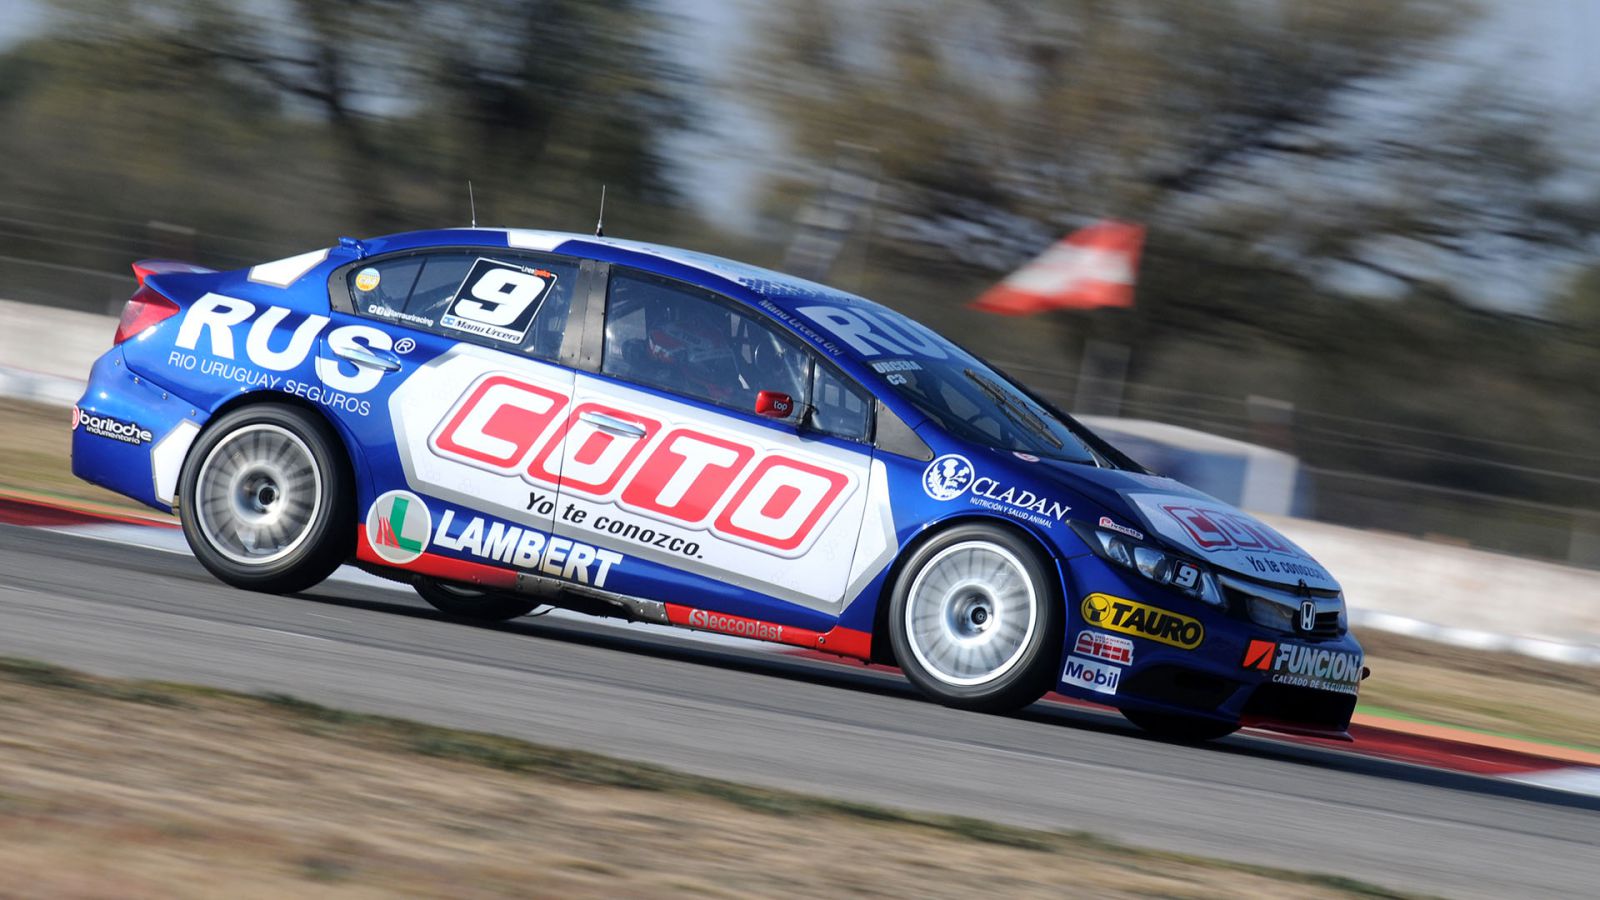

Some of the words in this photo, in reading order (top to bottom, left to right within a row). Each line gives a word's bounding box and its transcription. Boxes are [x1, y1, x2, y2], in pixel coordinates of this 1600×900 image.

[454, 268, 546, 326] 9
[454, 320, 484, 333] Manu
[485, 326, 520, 341] Urcera
[872, 360, 923, 373] URCERA
[886, 373, 907, 385] C3
[168, 351, 197, 370] RIO
[201, 358, 281, 395] URUGUAY
[283, 380, 371, 417] SEGUROS
[80, 409, 152, 441] bariloche
[86, 425, 140, 445] indumentaria
[435, 375, 849, 550] COTO
[971, 477, 1072, 520] CLADAN
[526, 492, 554, 515] Yo
[562, 503, 587, 523] te
[593, 515, 703, 559] conozco.
[1008, 507, 1029, 519] SALUD
[1029, 515, 1053, 529] ANIMAL
[433, 509, 624, 588] LAMBERT
[1175, 565, 1198, 587] 9
[1245, 555, 1266, 572] Yo
[1264, 557, 1280, 573] te
[689, 608, 783, 641] Seccoplast
[1111, 602, 1200, 645] TAURO
[1065, 661, 1118, 689] Mobil
[1272, 674, 1308, 687] CALZADO
[1310, 680, 1320, 688] DE
